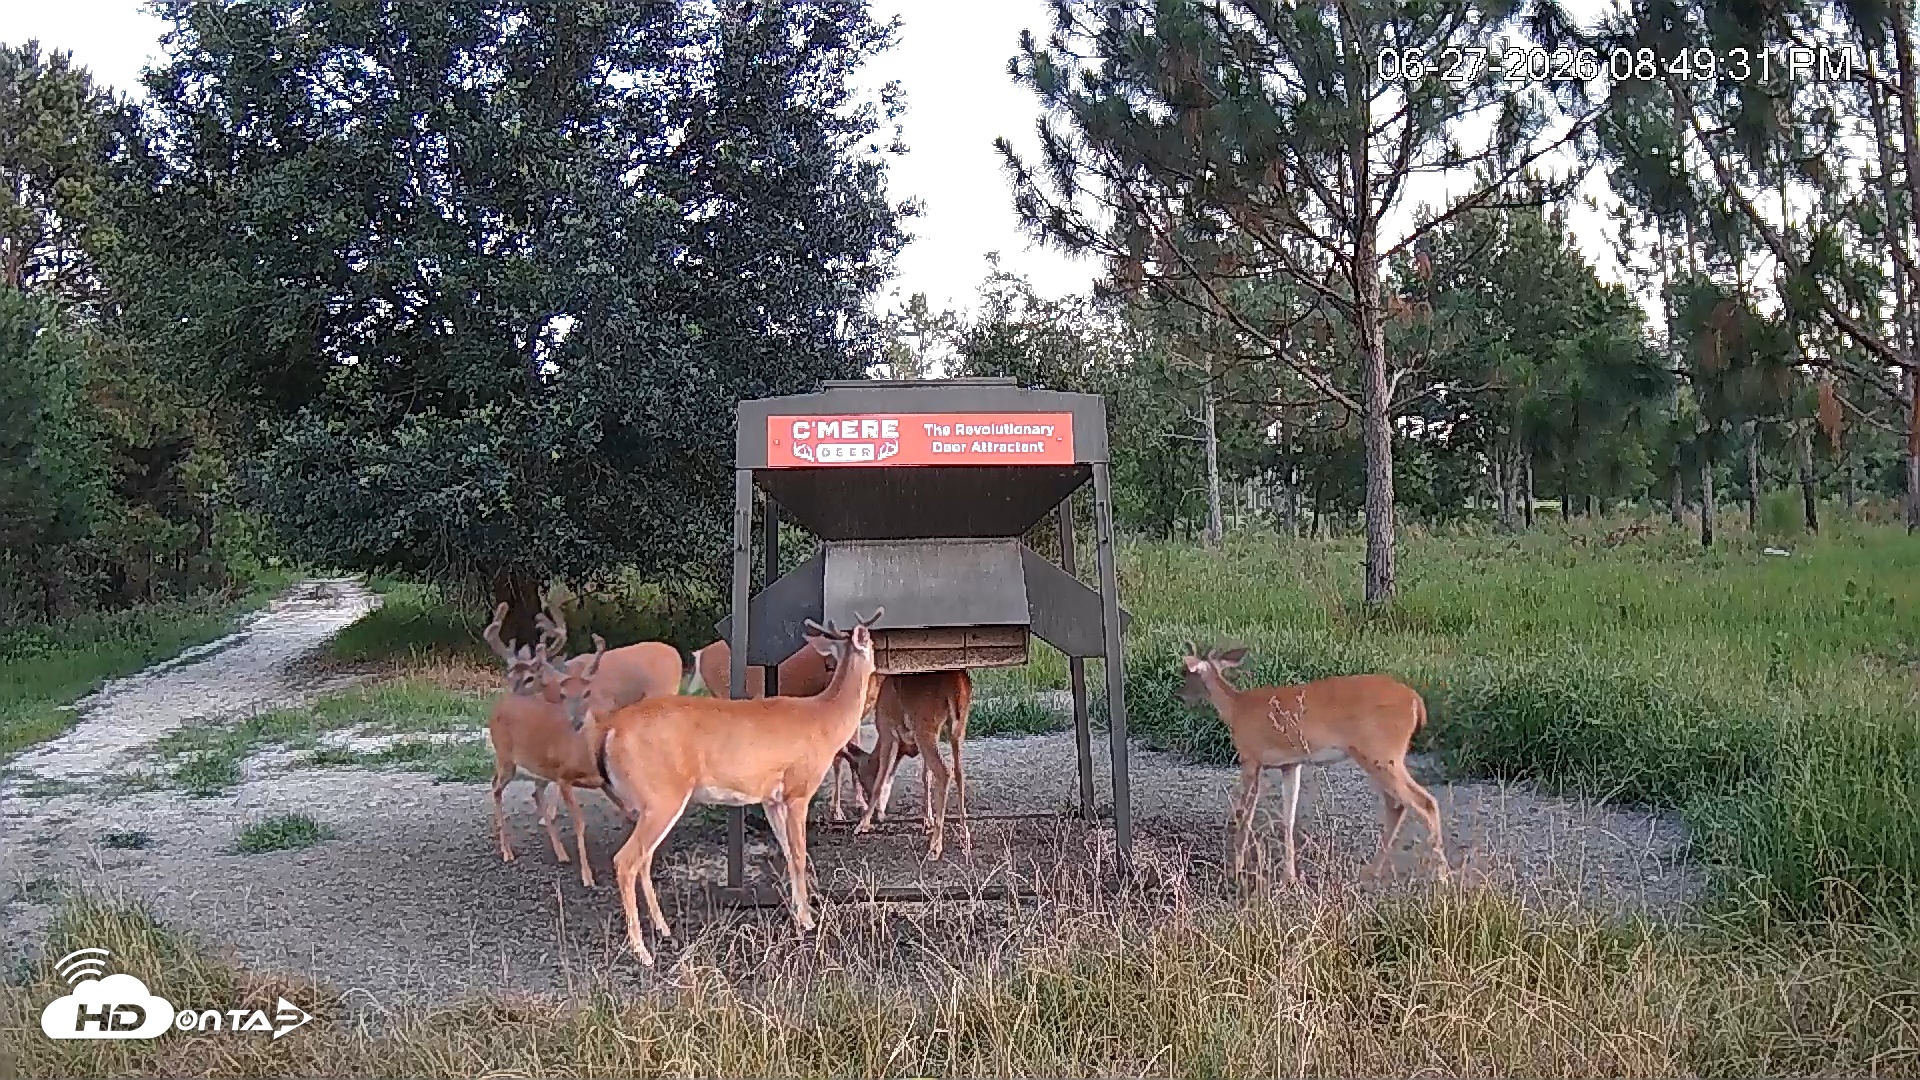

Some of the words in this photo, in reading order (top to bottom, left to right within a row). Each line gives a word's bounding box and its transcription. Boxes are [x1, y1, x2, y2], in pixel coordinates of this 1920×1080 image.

[792, 420, 900, 440] C'MERE
[923, 423, 951, 437] The
[955, 423, 1055, 438] Revolutionary
[821, 447, 871, 458] DEER
[932, 441, 967, 454] Deer
[971, 441, 1045, 454] Attractant
